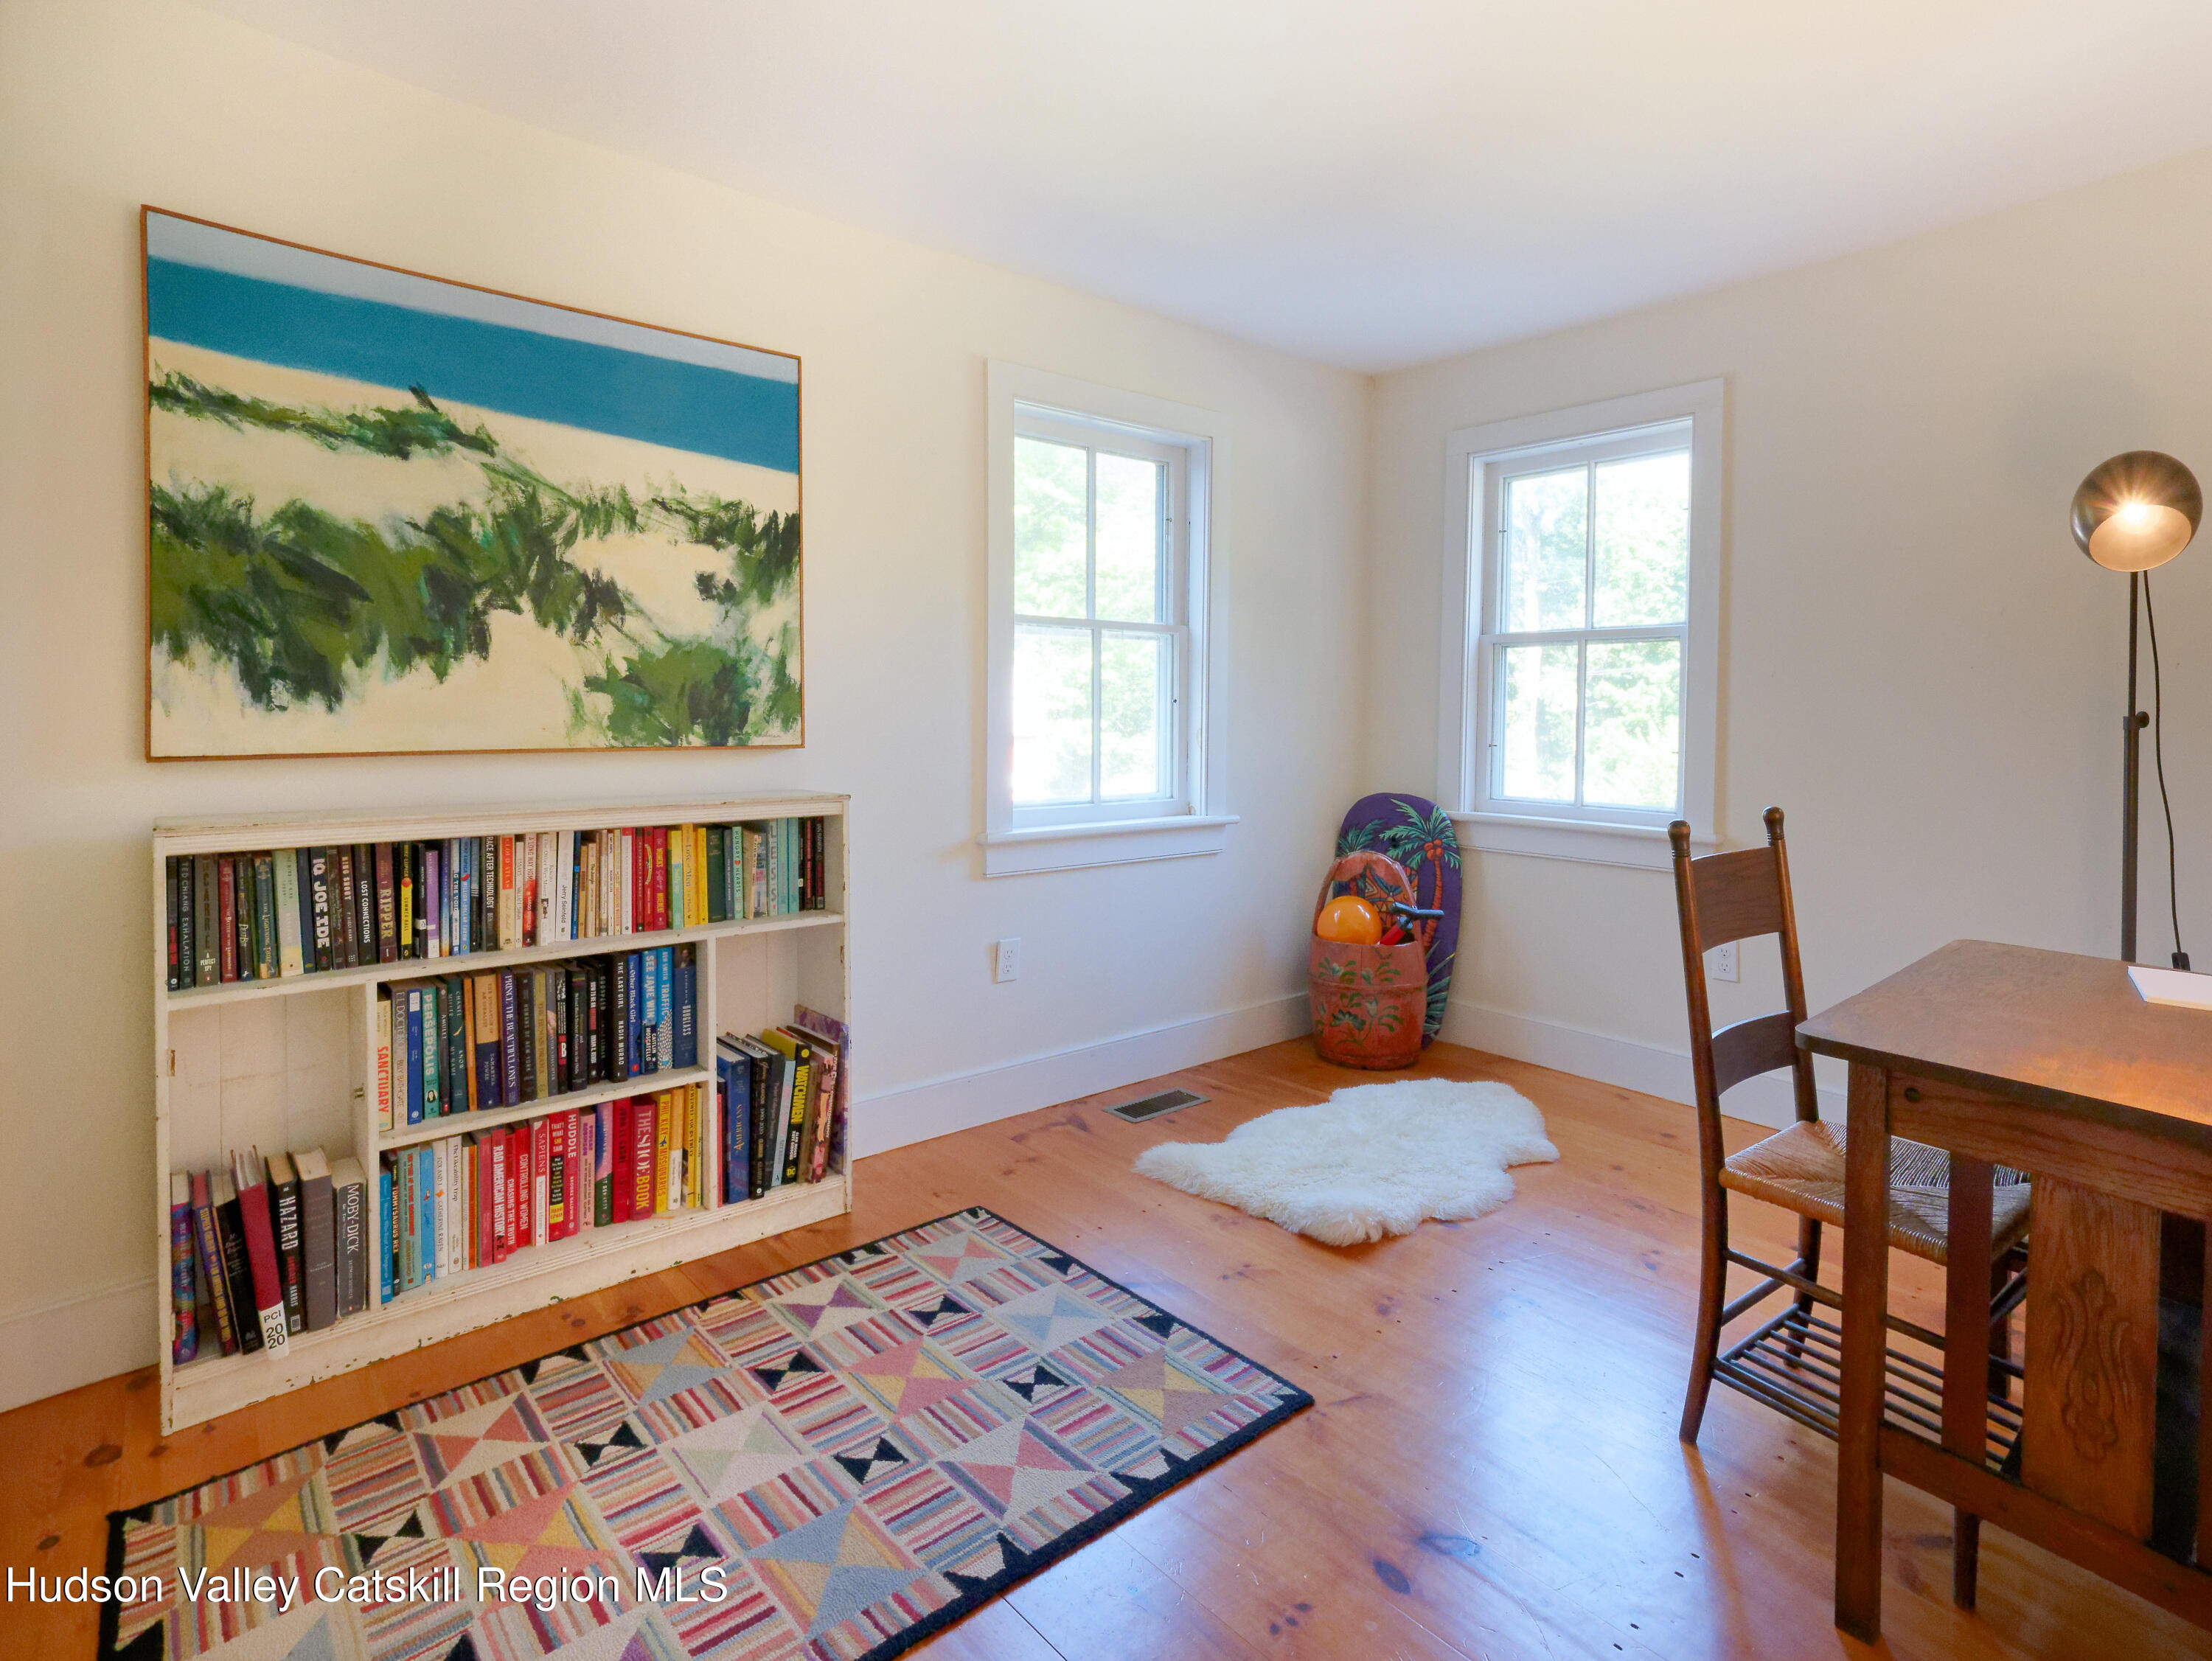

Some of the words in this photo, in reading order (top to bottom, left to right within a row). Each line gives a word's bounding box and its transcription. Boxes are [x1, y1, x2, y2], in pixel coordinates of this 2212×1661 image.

[313, 858, 325, 876] IQ
[313, 881, 328, 913] JOE
[380, 888, 393, 939] RIPPER
[316, 915, 330, 948] IDE
[362, 898, 370, 944] CONNECTIONS
[182, 917, 190, 972] EXHALATION
[646, 955, 655, 972] SEE
[646, 975, 655, 997] JANE
[661, 983, 669, 1016] TRAFFIC
[506, 1006, 514, 1022] THE
[647, 1000, 655, 1019] WIN
[683, 1005, 691, 1036] DOUGLASS
[424, 994, 434, 1076] PERSEPOLIS
[507, 1023, 515, 1065] BEAUTIFUL
[378, 1046, 389, 1113] SANCTUARY
[507, 1065, 516, 1087] ONES
[661, 1101, 669, 1117] PHIL
[791, 1065, 809, 1124] WATCHMEN
[552, 1129, 563, 1138] WHAT
[568, 1114, 576, 1158] HUDDLE
[638, 1110, 652, 1135] THE
[734, 1104, 745, 1151] AMERICANS
[493, 1145, 504, 1163] RAD
[636, 1134, 651, 1176] SHOE
[493, 1163, 504, 1203] AMERICAN
[520, 1153, 528, 1201] CONTROLLING
[658, 1146, 667, 1197] MISSIONARIES
[636, 1175, 650, 1210] BOOK
[279, 1196, 299, 1251] HAZARD
[347, 1184, 360, 1255] MOBY-DICK
[495, 1204, 504, 1237] HISTORY
[520, 1203, 528, 1230] WOMEN
[290, 1285, 298, 1306] HARRIS
[264, 1310, 281, 1323] PCI
[266, 1323, 283, 1339] 20
[268, 1334, 285, 1350] 20
